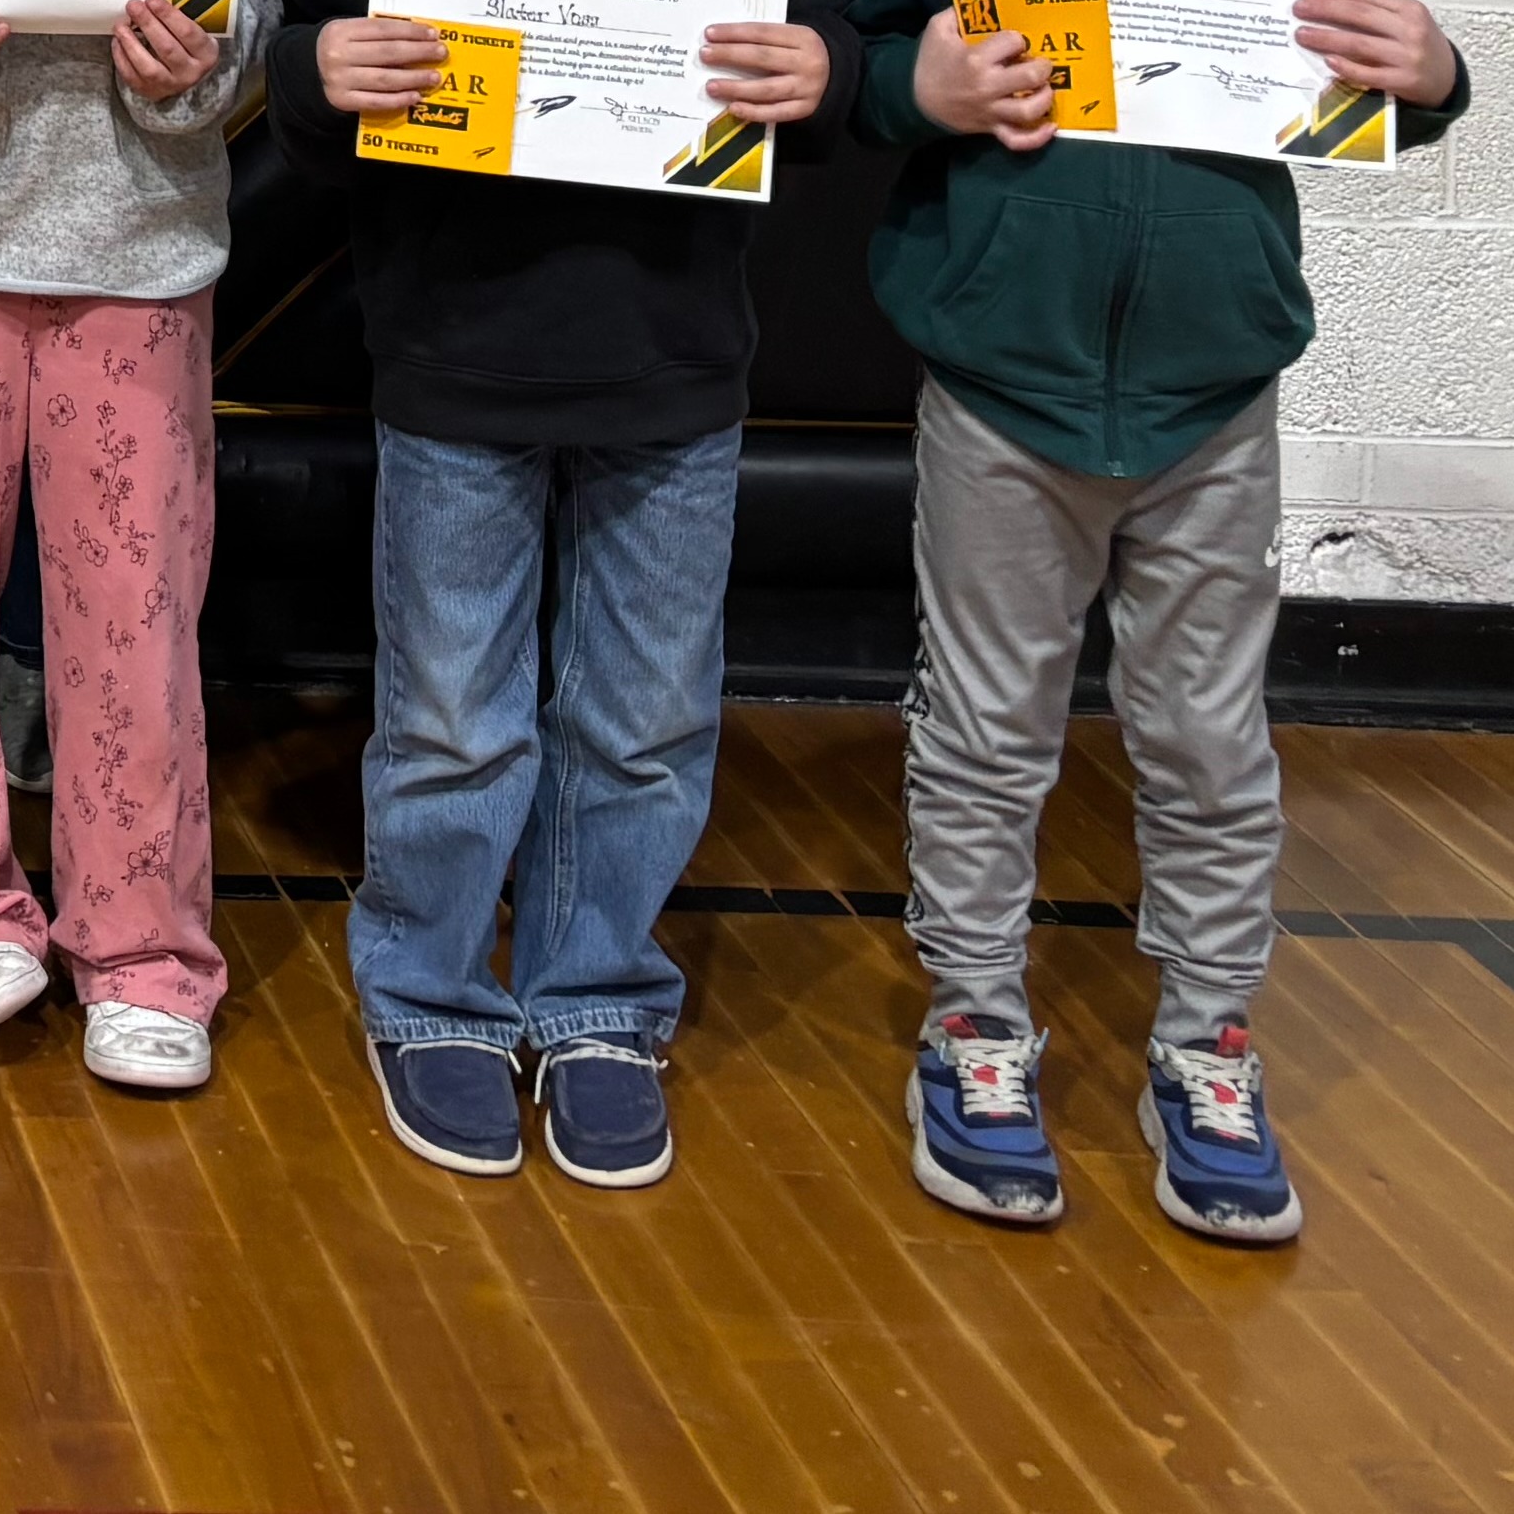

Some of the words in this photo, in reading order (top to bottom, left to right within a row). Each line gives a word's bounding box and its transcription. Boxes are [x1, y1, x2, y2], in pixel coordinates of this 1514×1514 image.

[438, 28, 459, 43] 50
[461, 33, 515, 50] TICKETS
[362, 133, 383, 148] 50
[385, 139, 440, 157] TICKETS
